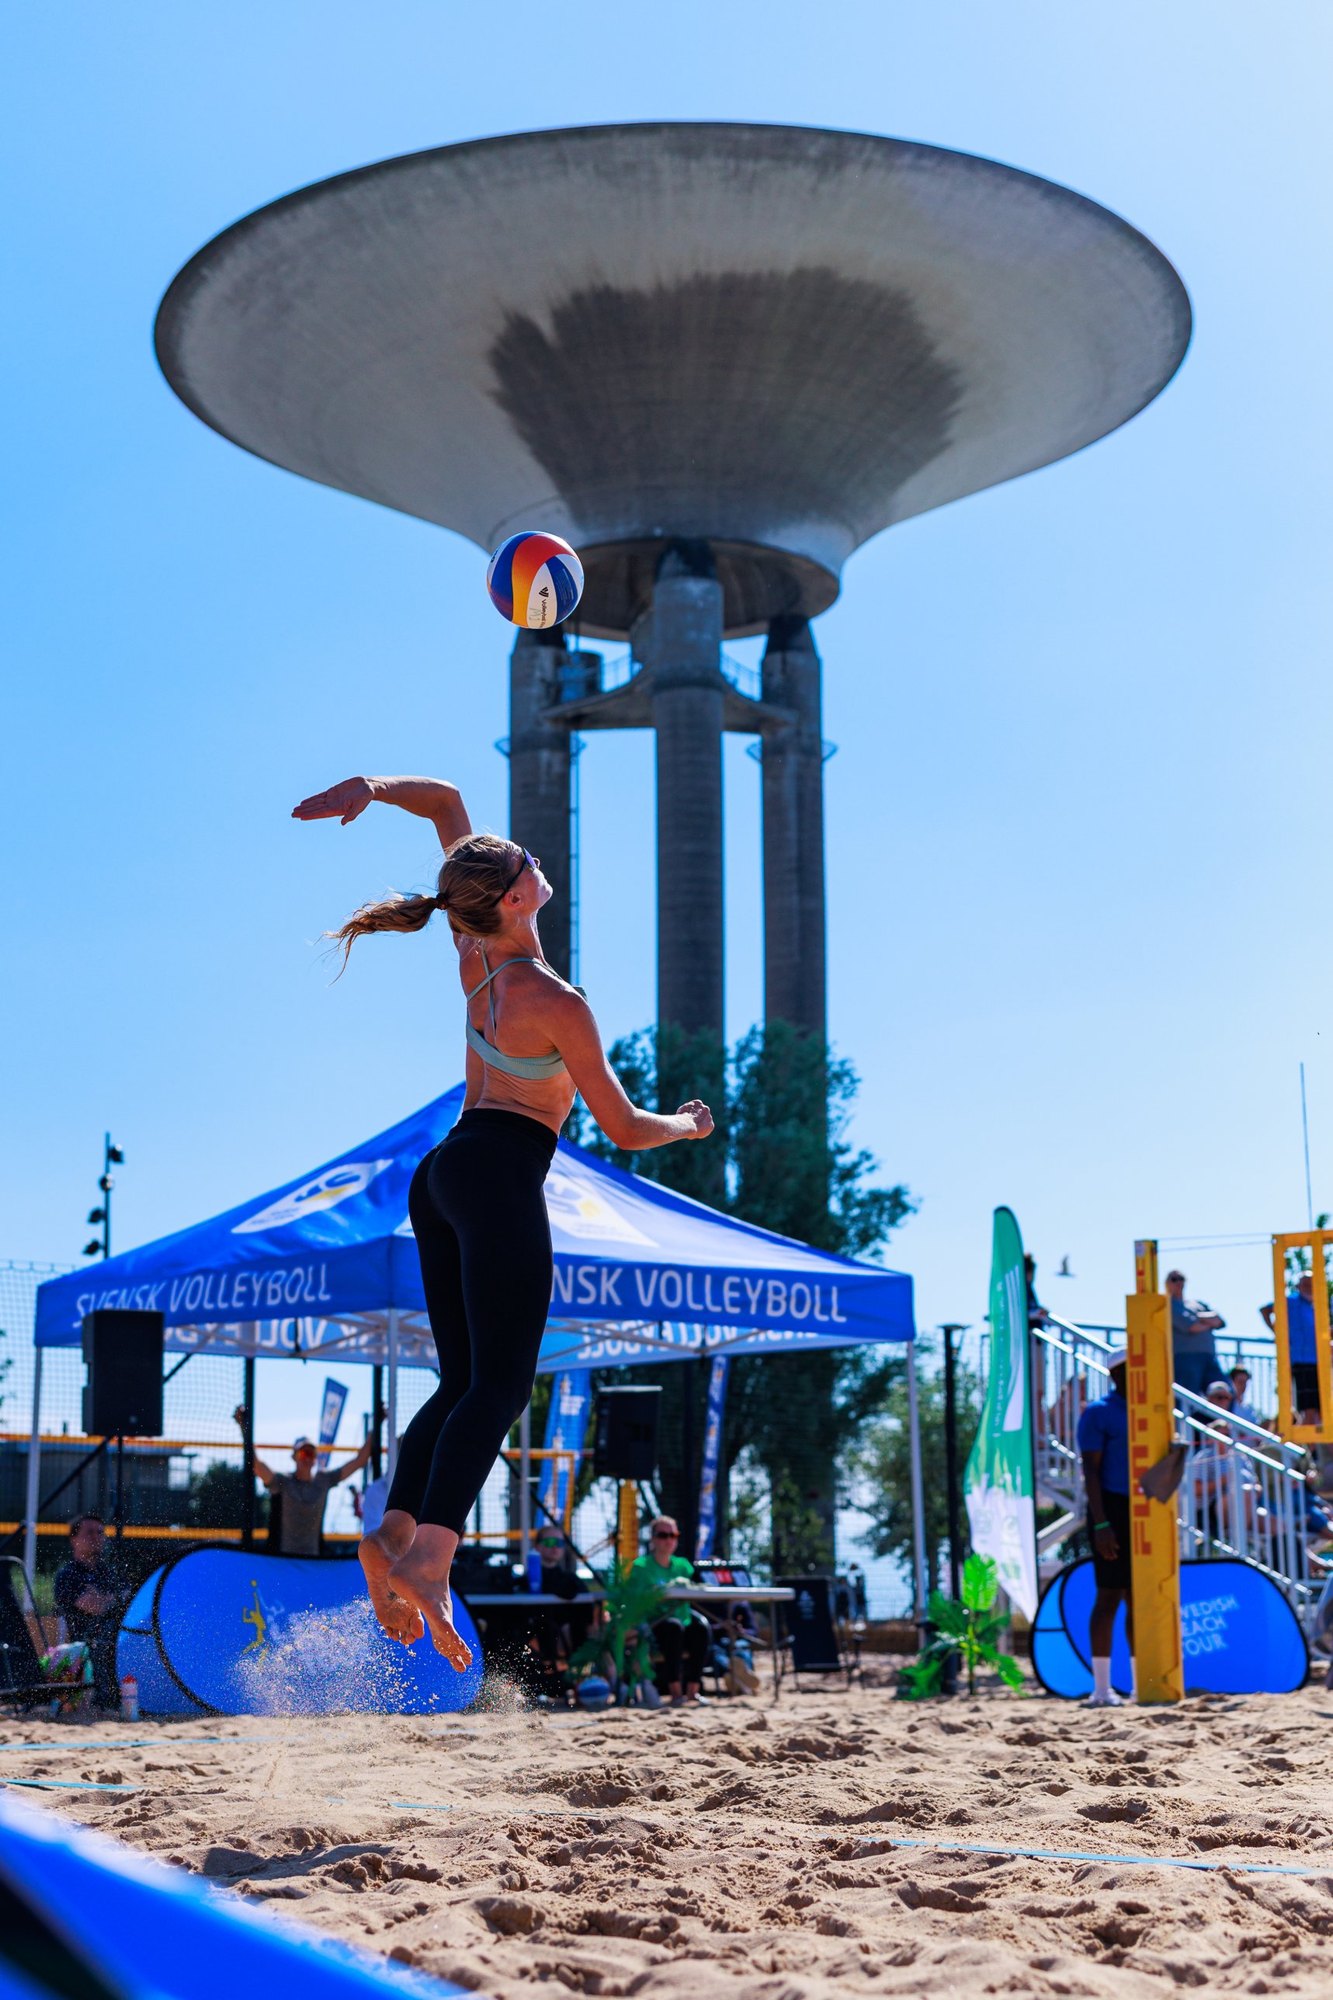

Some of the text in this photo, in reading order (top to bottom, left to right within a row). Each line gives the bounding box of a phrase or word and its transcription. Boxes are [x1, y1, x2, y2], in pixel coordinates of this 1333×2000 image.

[169, 1264, 332, 1312] VOLLEYBOLL
[551, 1265, 847, 1323] NSK VOLLEYBOLL
[1128, 1332, 1153, 1556] FUNTEC
[1180, 1614, 1228, 1637] EACH
[1181, 1633, 1229, 1656] OUR
